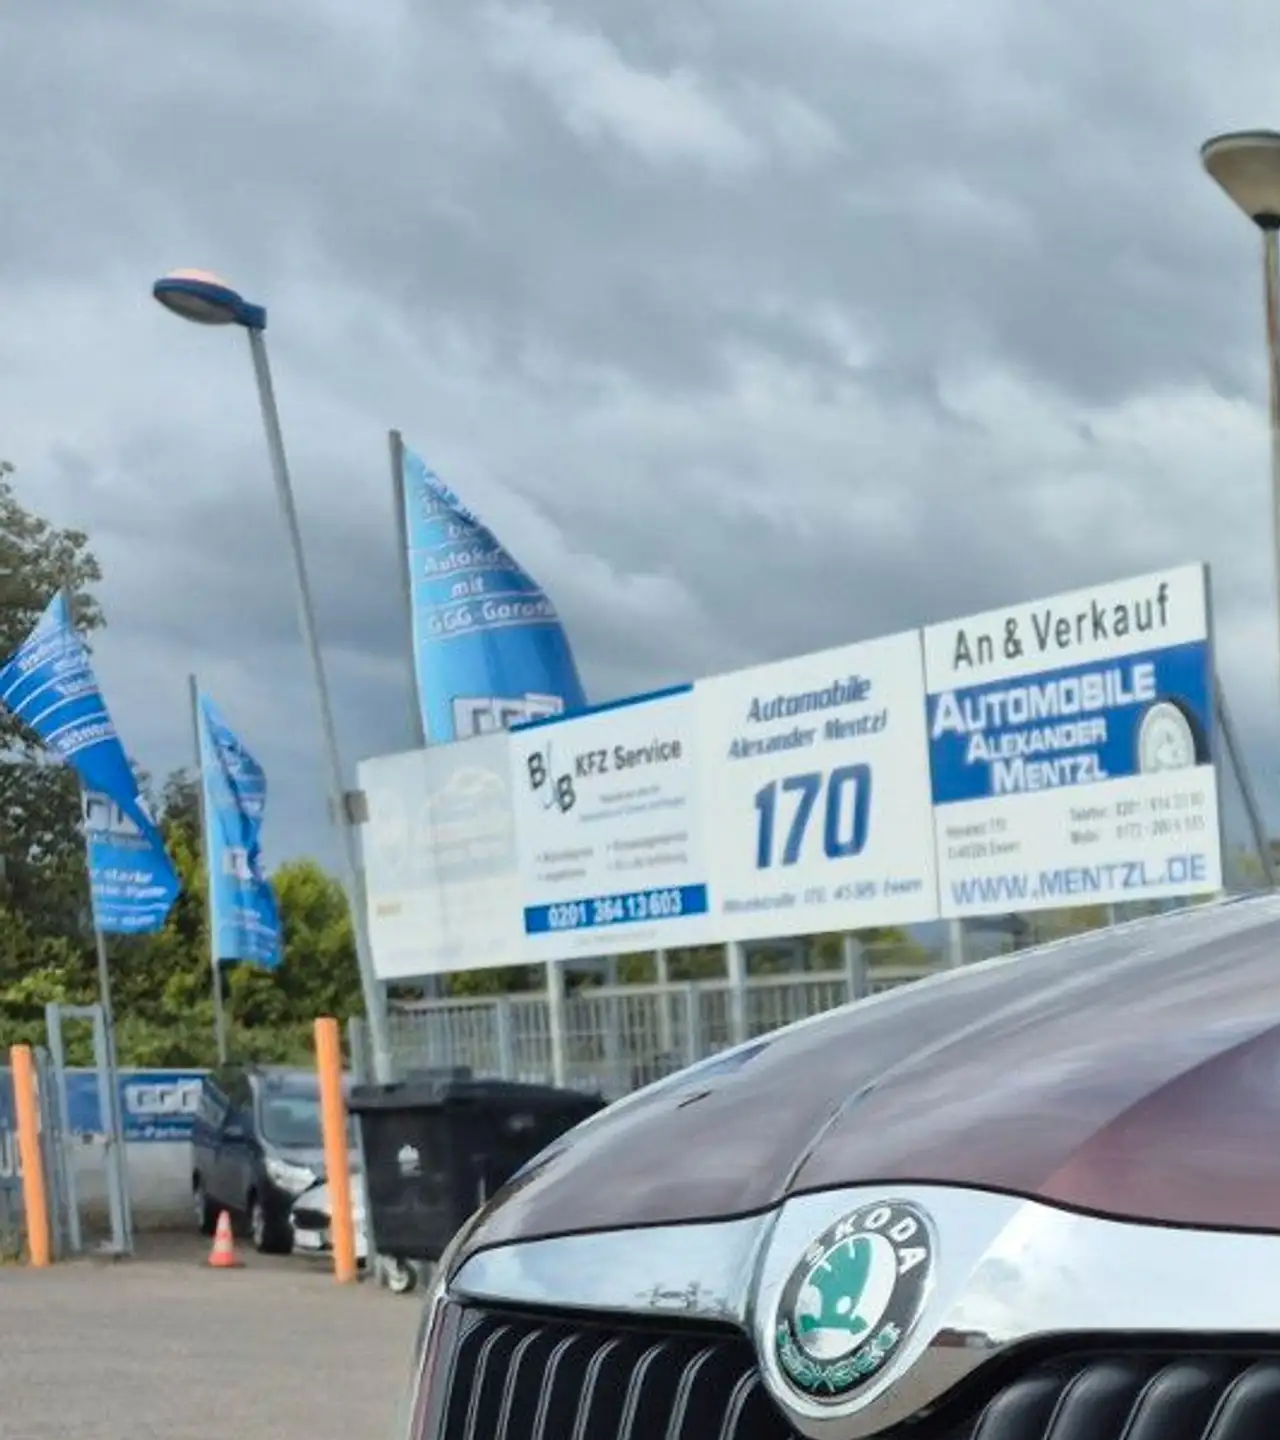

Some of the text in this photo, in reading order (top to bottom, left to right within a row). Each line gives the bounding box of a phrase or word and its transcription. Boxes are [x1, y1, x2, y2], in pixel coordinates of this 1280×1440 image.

[953, 582, 1169, 670] An & Verkauf
[747, 674, 872, 722] Automobile
[931, 662, 1156, 740] AUTOMOBILE
[575, 739, 682, 778] KFZ Service
[728, 707, 888, 760] Alexander Mentzl
[967, 717, 1107, 762] ALEXANDER
[993, 753, 1108, 796] MENTZL
[754, 762, 872, 869] 170
[950, 854, 1206, 906] WWW.MENTZL.DE
